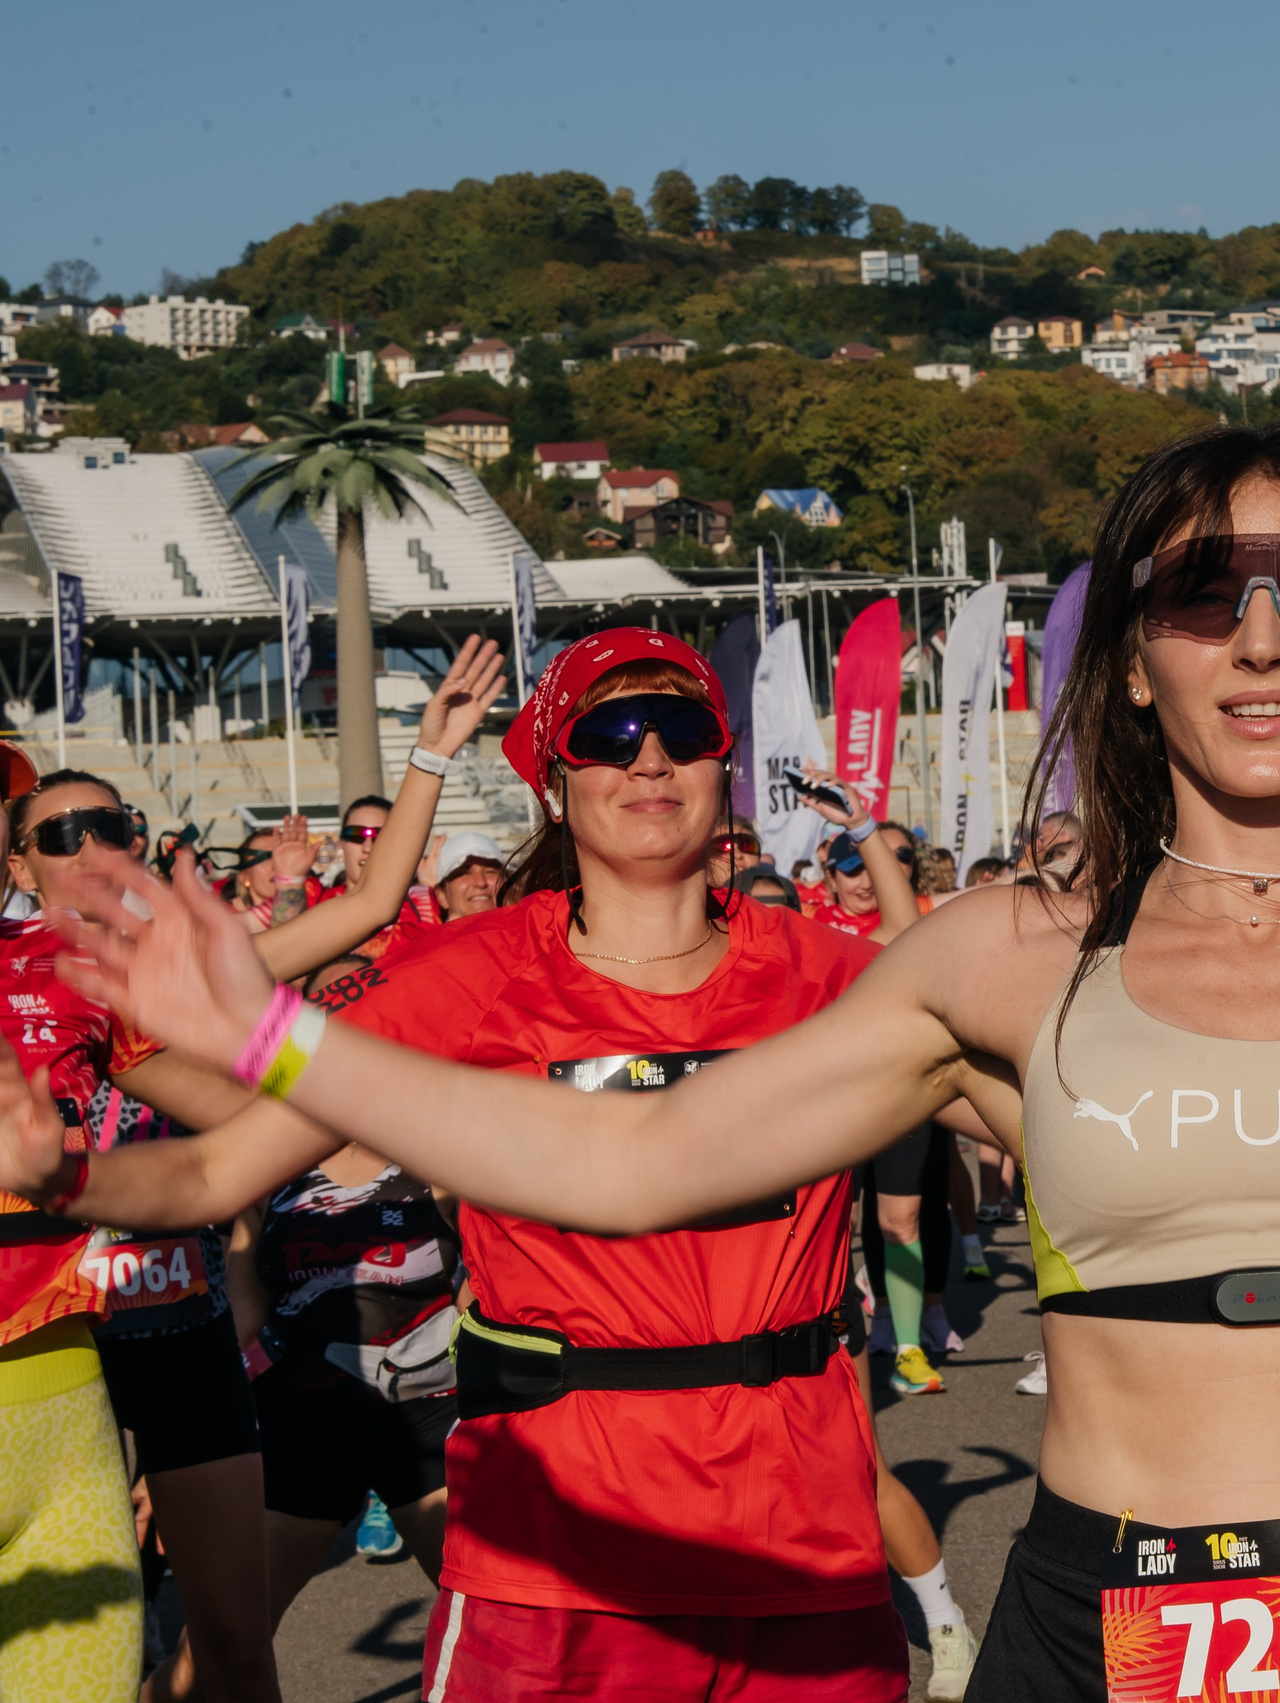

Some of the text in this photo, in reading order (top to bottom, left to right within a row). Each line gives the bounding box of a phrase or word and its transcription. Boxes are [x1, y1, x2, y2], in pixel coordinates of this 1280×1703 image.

[643, 1074, 665, 1086] STAR
[84, 1246, 192, 1297] 7064
[1138, 1538, 1166, 1555] IRON
[1205, 1532, 1238, 1560] 10
[1228, 1541, 1249, 1554] IRON
[1137, 1553, 1177, 1576] LADY
[1229, 1552, 1260, 1569] STAR
